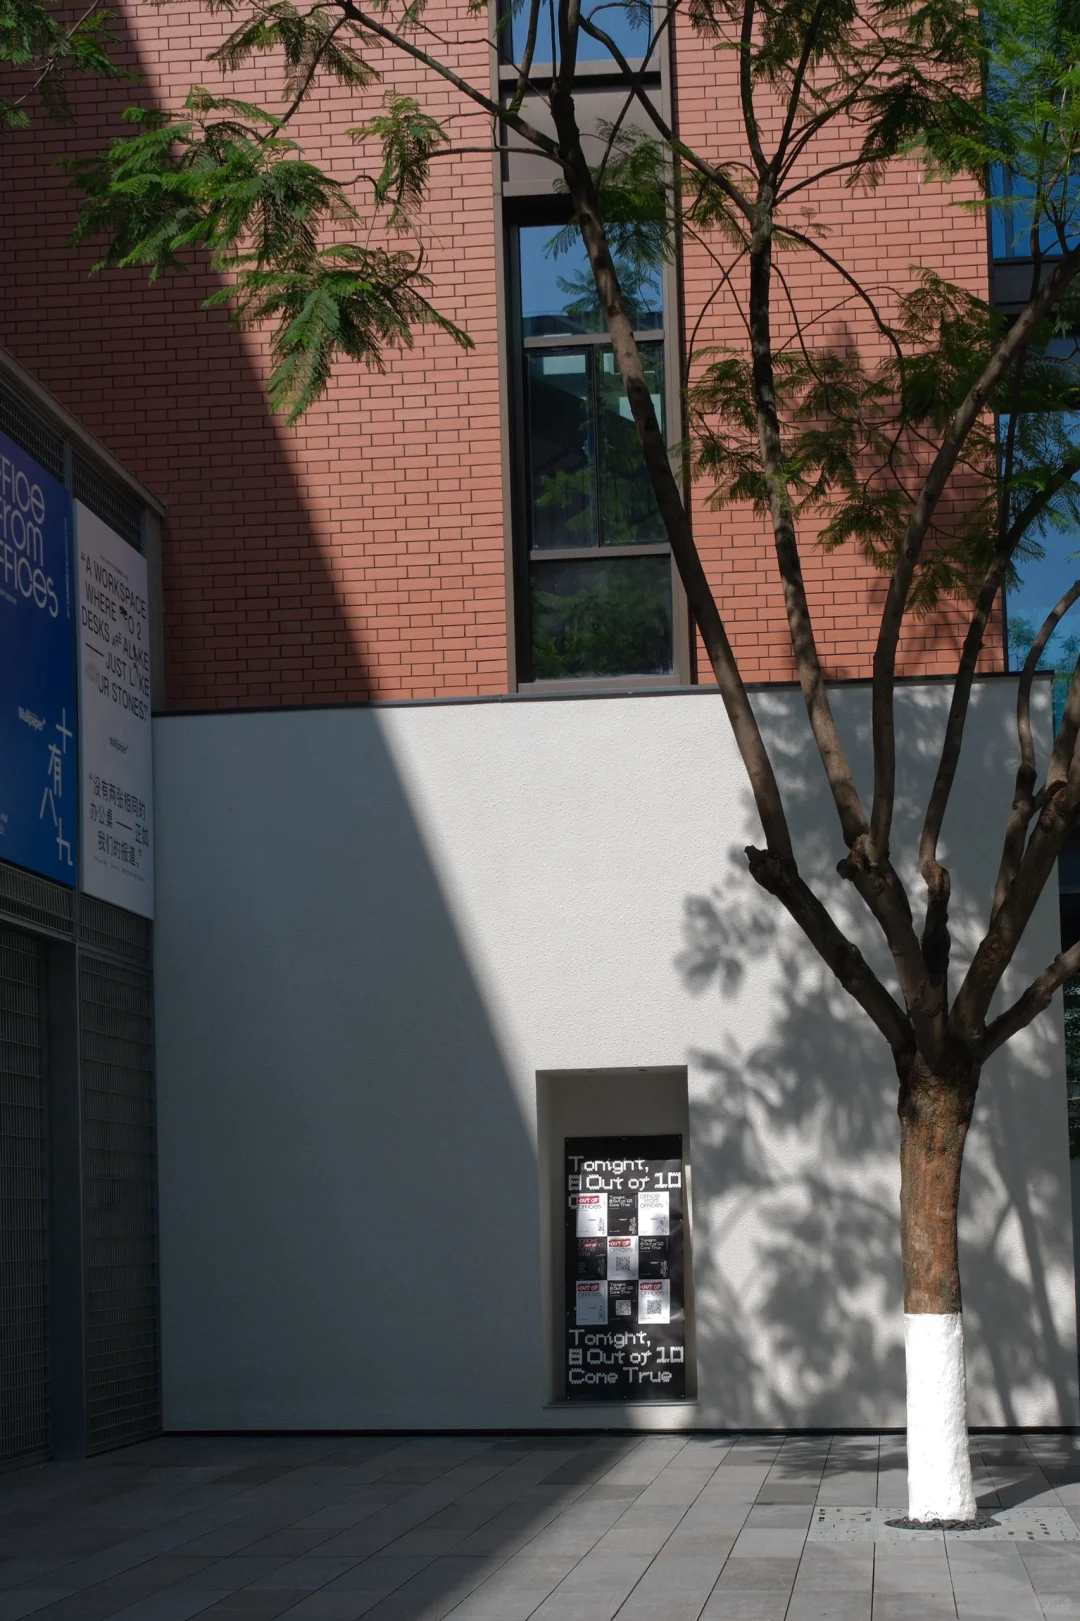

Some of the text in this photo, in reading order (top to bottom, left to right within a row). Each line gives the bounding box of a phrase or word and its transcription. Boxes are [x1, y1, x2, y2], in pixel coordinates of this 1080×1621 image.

[0, 496, 44, 567] rom
[94, 560, 147, 620] WORKSPACE
[82, 605, 110, 643] DESKS
[85, 580, 117, 623] WHERE
[136, 621, 142, 642] 2
[106, 651, 127, 681] JUST
[586, 1174, 624, 1191] Out
[628, 1176, 650, 1191] of
[654, 1171, 682, 1189] 10
[569, 1328, 651, 1349] Tonight,
[586, 1348, 626, 1365] Out
[629, 1350, 652, 1366] of
[656, 1346, 684, 1364] 10
[568, 1366, 673, 1385] Come True
